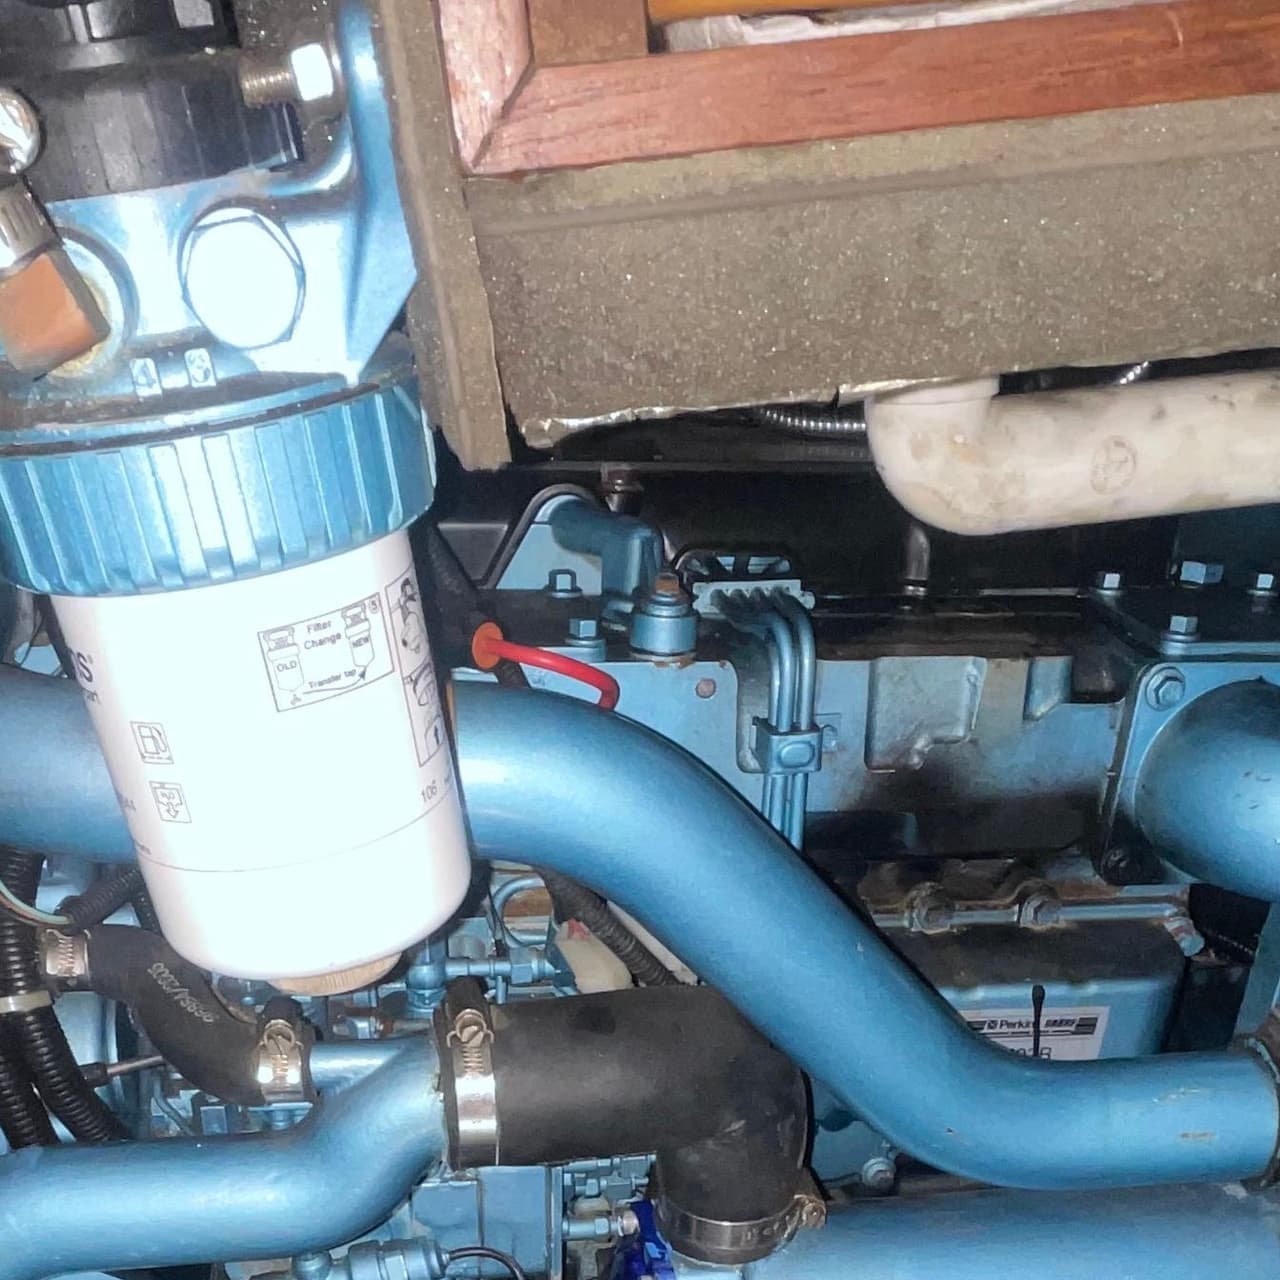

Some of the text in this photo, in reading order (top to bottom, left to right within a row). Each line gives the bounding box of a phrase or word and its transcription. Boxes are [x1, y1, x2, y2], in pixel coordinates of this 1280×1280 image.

[306, 620, 332, 634] Filter
[303, 633, 342, 650] Change
[351, 636, 370, 649] NEW
[276, 660, 298, 673] OLD
[308, 668, 357, 689] Transfer tap
